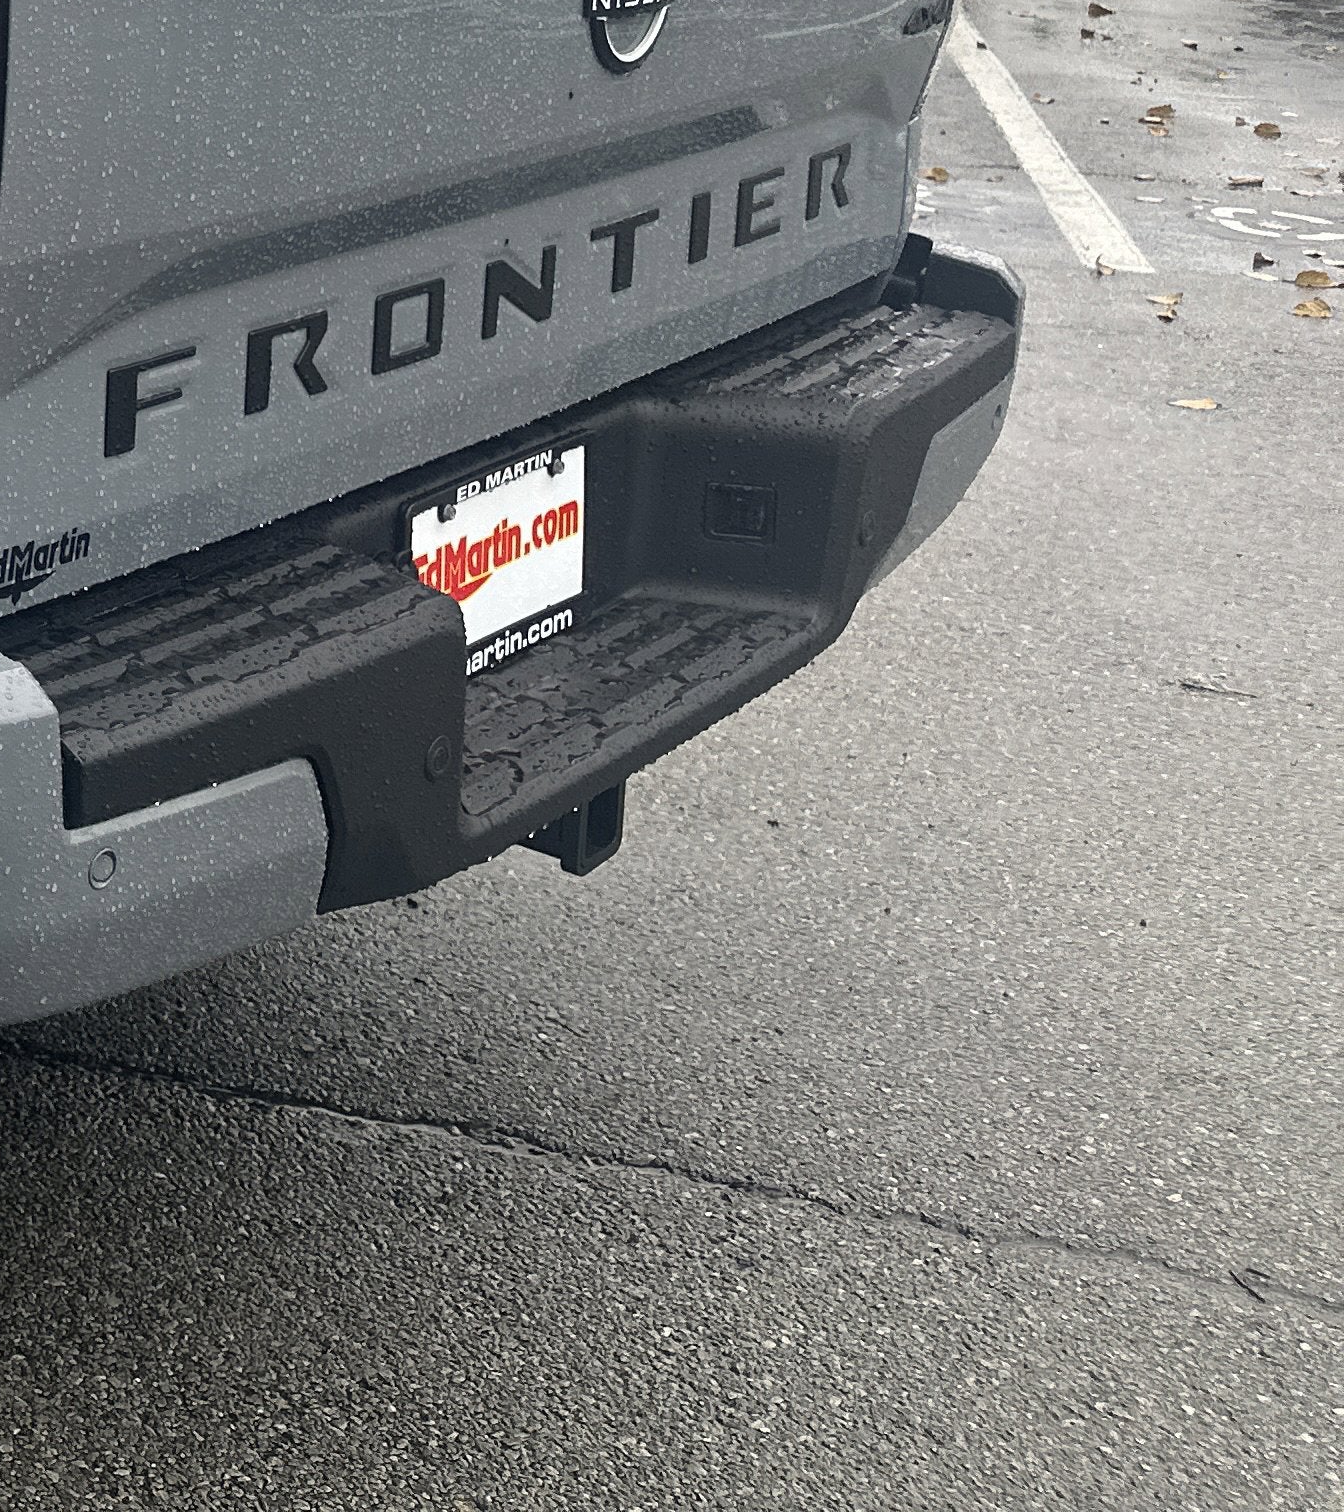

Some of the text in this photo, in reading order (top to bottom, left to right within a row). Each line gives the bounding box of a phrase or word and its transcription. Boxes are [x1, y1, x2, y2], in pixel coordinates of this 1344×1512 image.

[103, 142, 853, 458] FRONTIER
[456, 450, 553, 503] ED MARTIN
